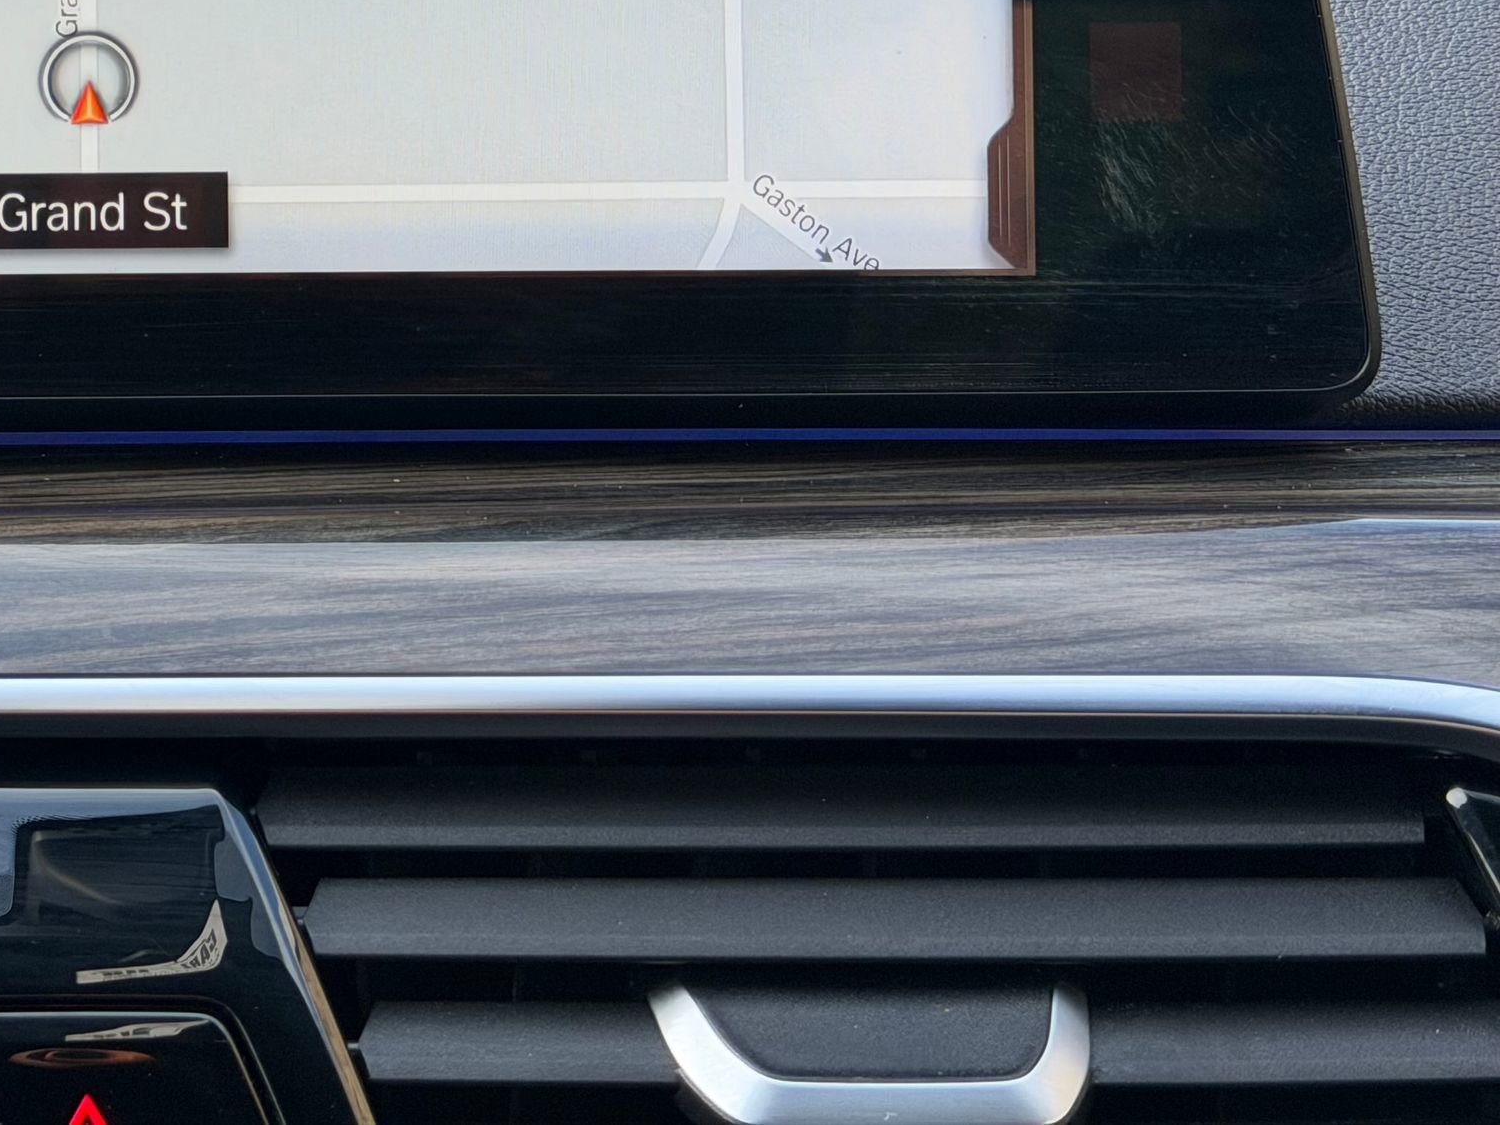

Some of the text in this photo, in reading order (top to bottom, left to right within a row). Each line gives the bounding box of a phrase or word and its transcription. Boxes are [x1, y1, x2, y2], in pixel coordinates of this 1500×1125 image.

[142, 190, 189, 232] St
[752, 174, 881, 271] Gaston Ave
